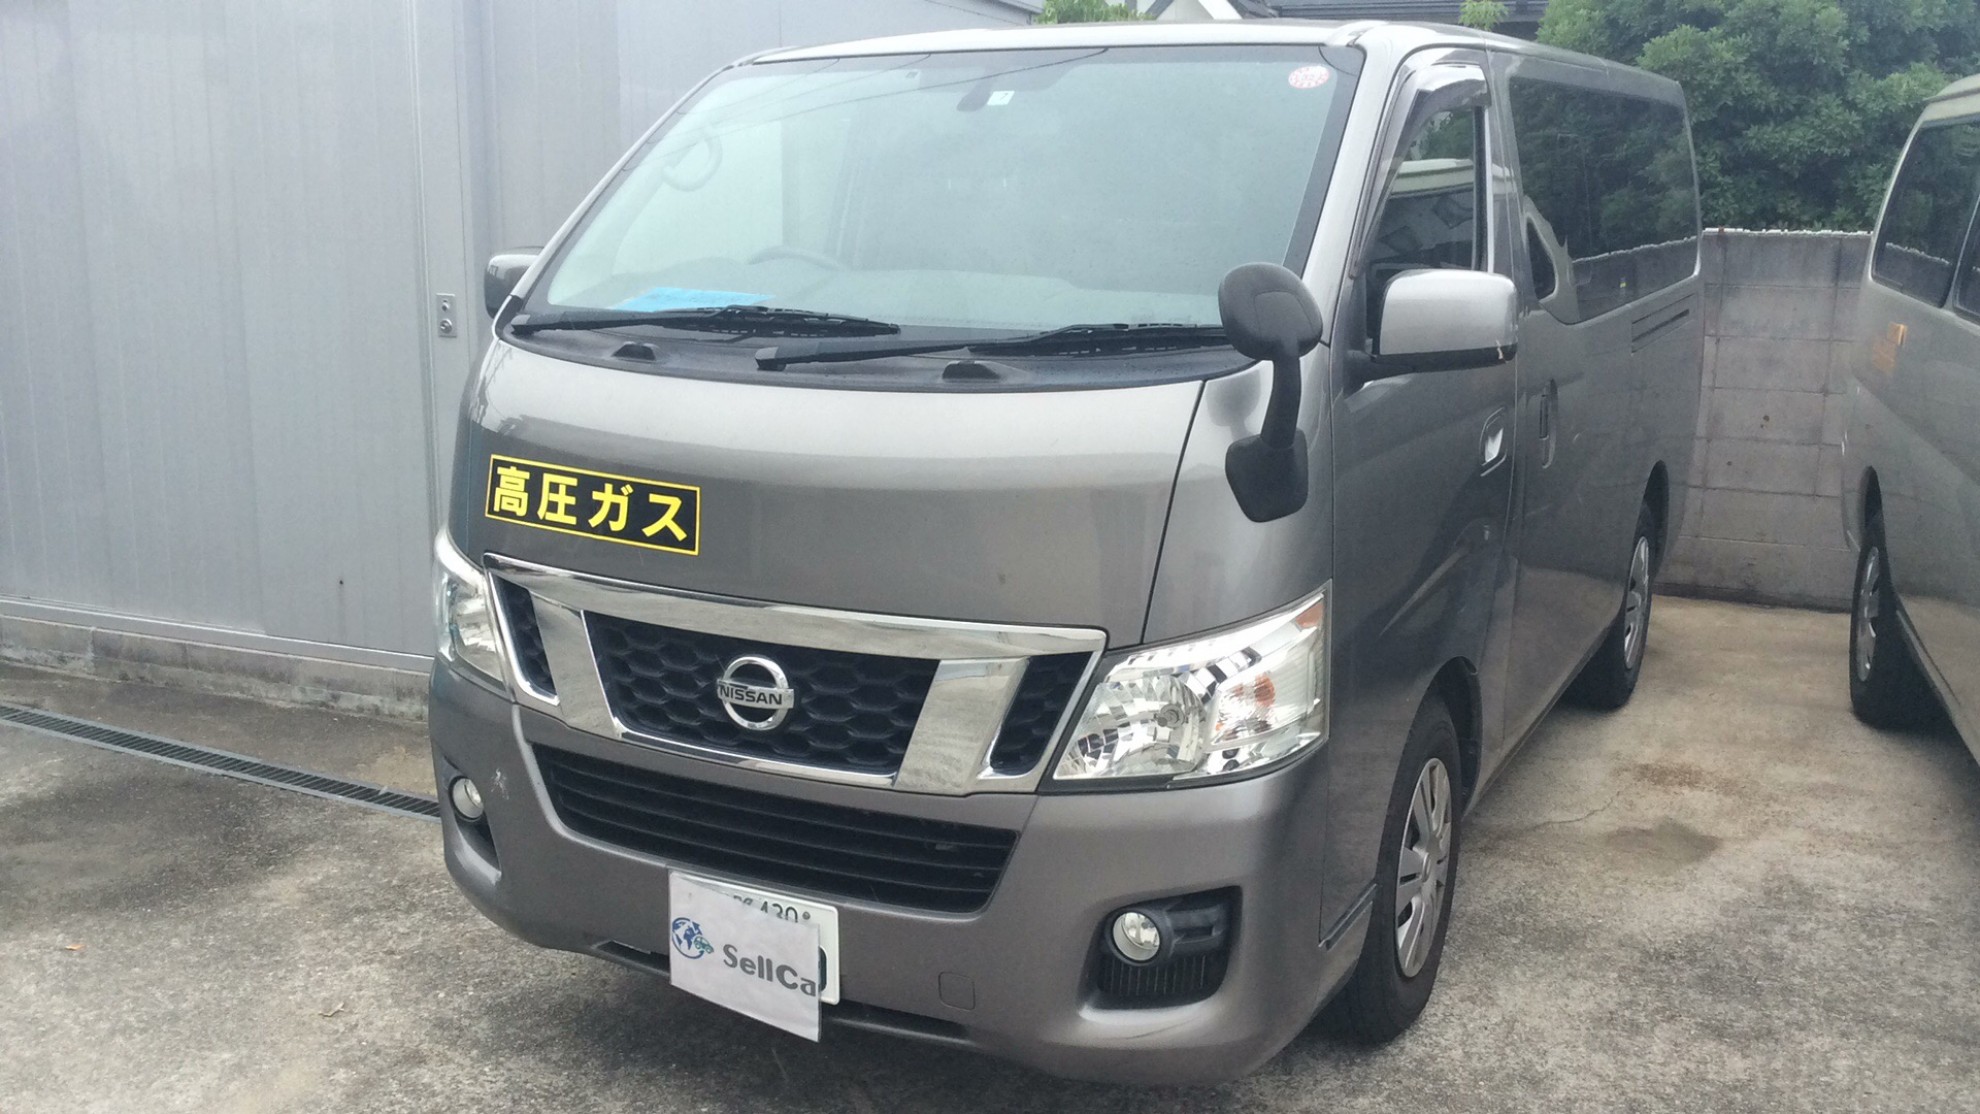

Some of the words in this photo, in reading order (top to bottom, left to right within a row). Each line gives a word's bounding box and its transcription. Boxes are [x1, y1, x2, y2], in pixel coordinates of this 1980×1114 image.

[493, 466, 688, 542] 高圧ガス
[719, 685, 783, 706] NISSAN
[722, 943, 817, 997] SellCa
